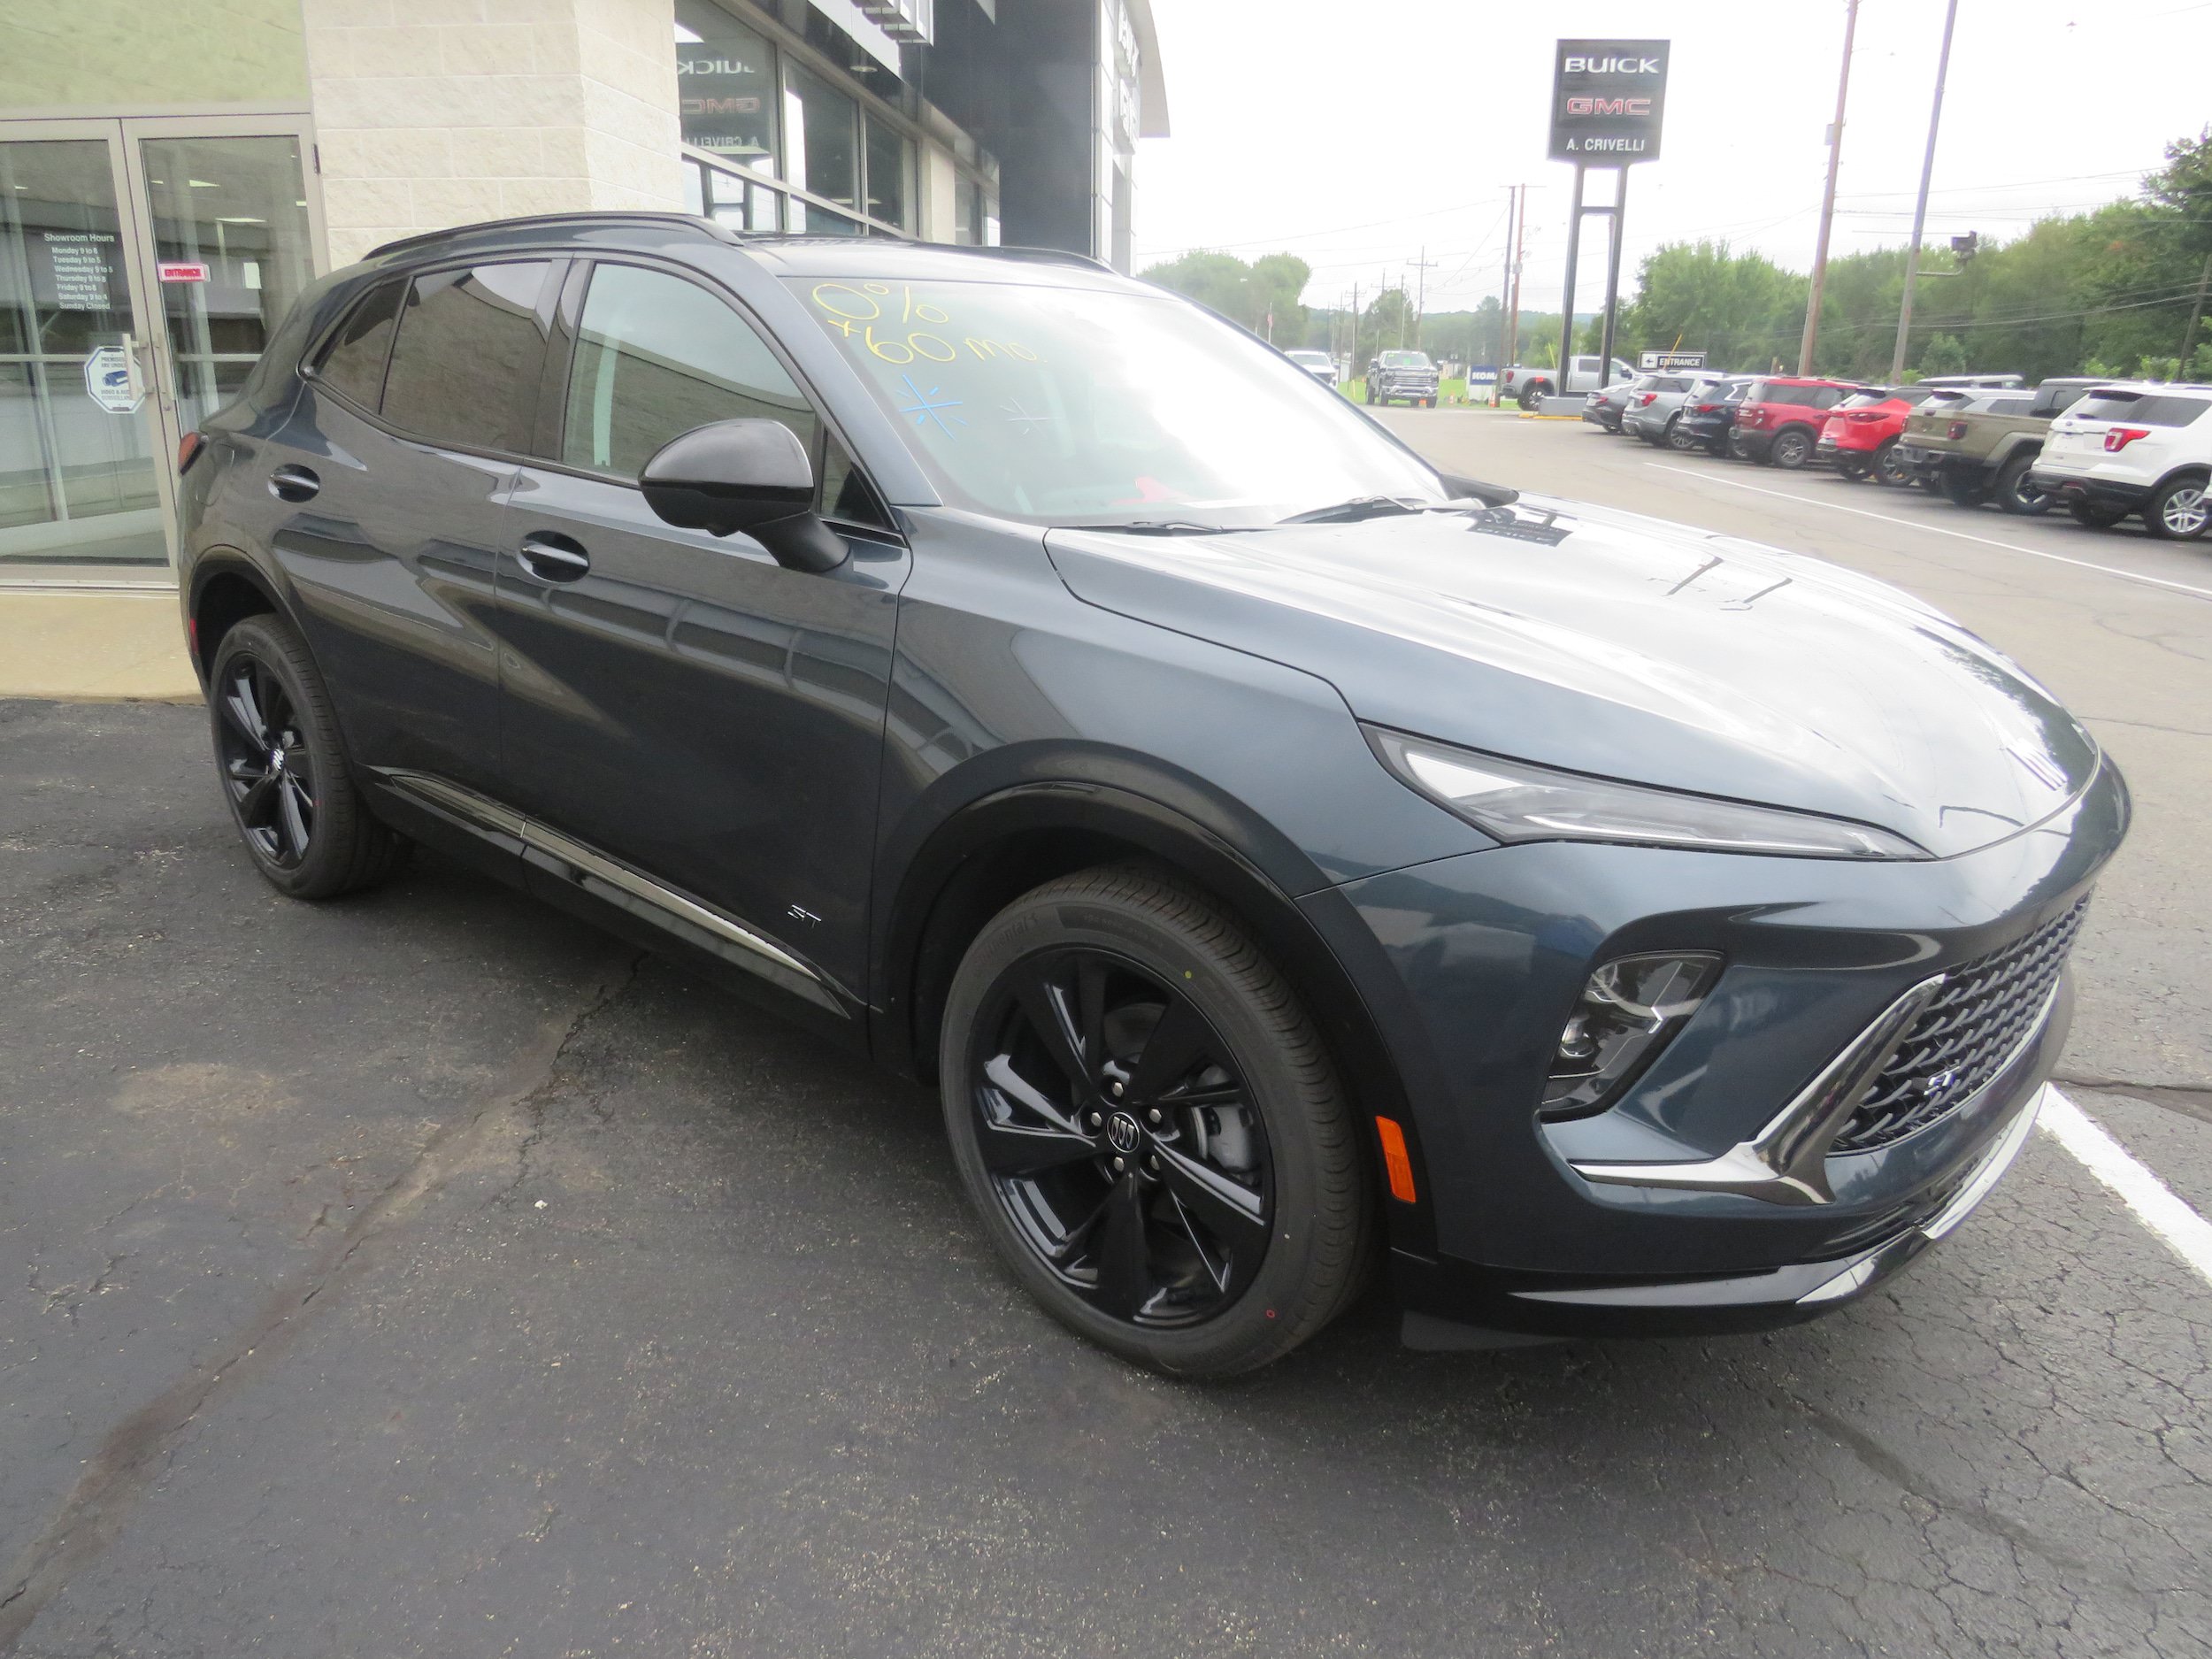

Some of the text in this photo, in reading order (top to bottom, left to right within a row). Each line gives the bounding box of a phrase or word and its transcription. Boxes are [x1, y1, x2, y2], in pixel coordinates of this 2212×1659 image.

[1564, 58, 1660, 73] BUICK
[1567, 97, 1651, 116] GMC
[1566, 137, 1645, 151] A. CRIVELLI
[44, 233, 115, 242] Showroom Hours
[53, 256, 81, 265] Tuesday
[55, 274, 87, 283] Thursday
[57, 283, 78, 292] Friday
[59, 302, 85, 311] Sunday
[812, 283, 949, 324] 0%
[1659, 357, 1701, 366] ENTRANCE
[787, 904, 822, 928] ST
